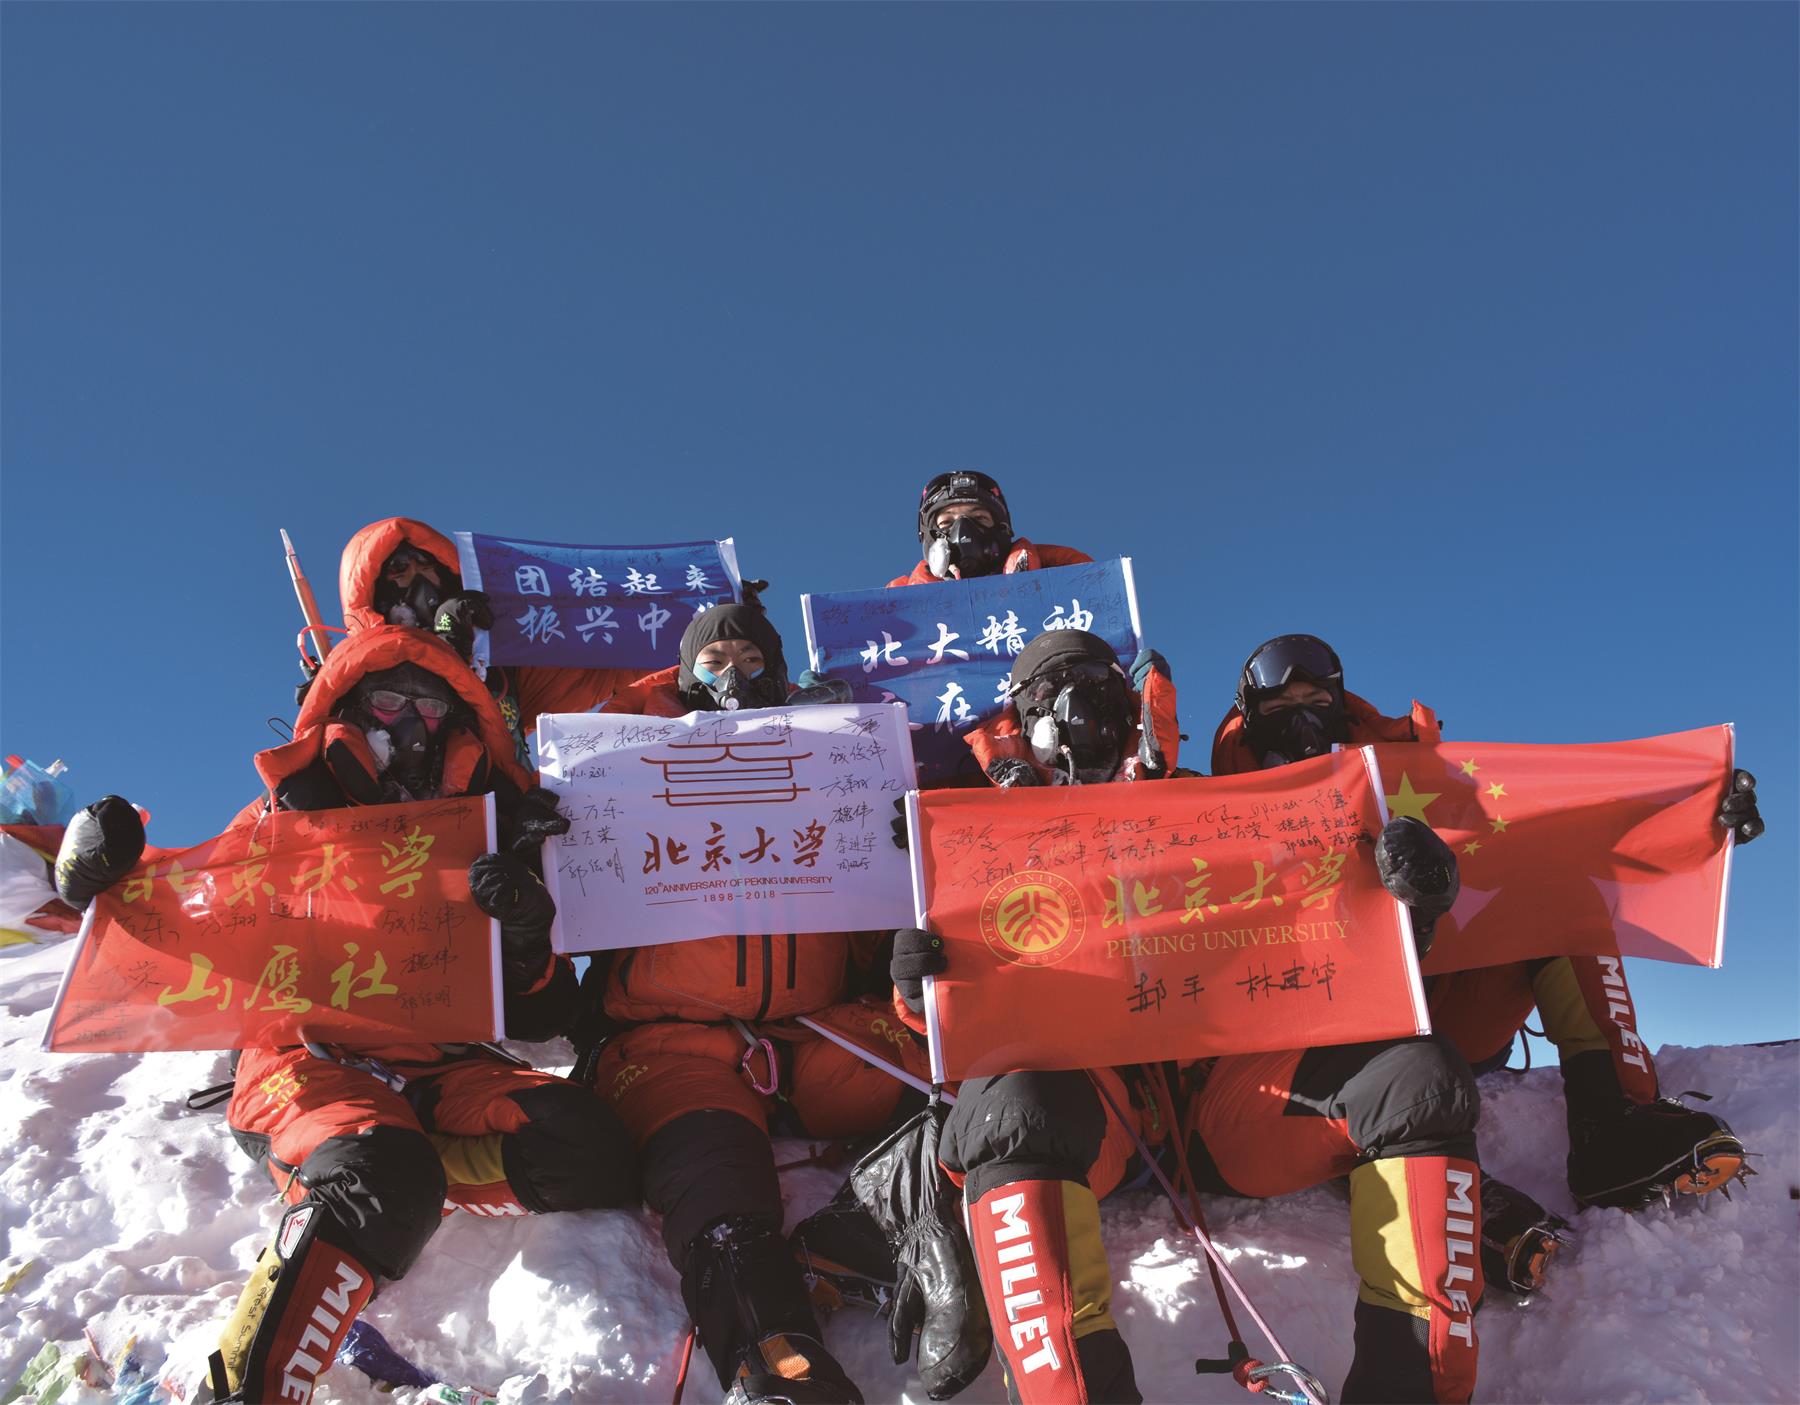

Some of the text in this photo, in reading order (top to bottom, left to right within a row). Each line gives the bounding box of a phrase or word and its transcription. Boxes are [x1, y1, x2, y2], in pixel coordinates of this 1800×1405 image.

[514, 564, 723, 597] 团结起来
[515, 602, 715, 650] 振兴中
[860, 599, 1094, 673] 北大精神
[663, 880, 727, 893] ANNIVERSARY
[730, 879, 743, 888] OF
[744, 877, 778, 886] PEKING
[779, 876, 833, 885] UNIVERSITY
[1106, 920, 1350, 959] PEKING UNIVERSITY
[1445, 1169, 1474, 1347] MILLET
[990, 1193, 1060, 1374] MILLET
